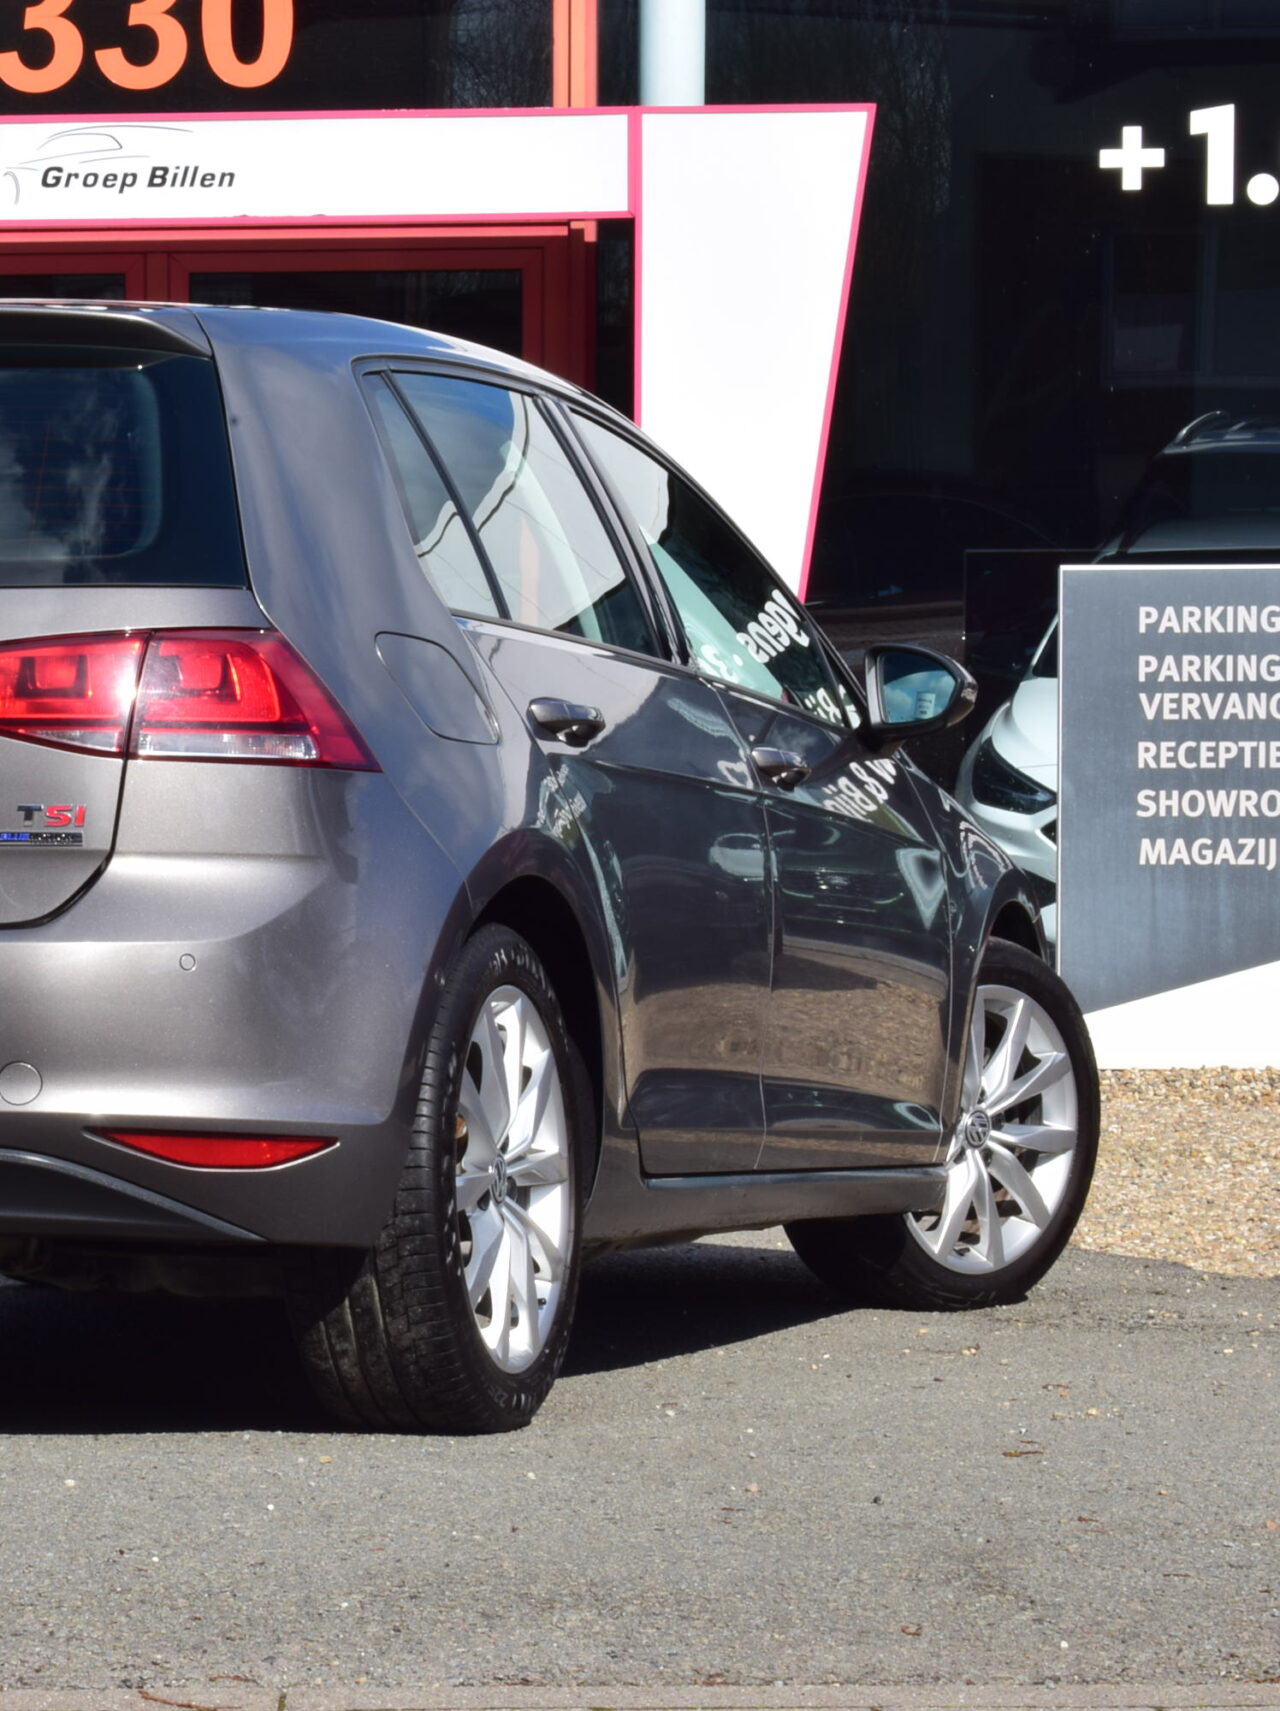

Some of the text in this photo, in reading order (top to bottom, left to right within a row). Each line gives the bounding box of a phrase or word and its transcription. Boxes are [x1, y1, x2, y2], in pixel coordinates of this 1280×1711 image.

[40, 165, 236, 194] Groep Billen
[1138, 605, 1280, 633] PARKING
[1138, 654, 1280, 682] PARKING
[1137, 741, 1280, 769] RECEPTIE
[17, 803, 87, 828] TSI
[1136, 789, 1280, 818] SHOWRO
[1138, 838, 1277, 870] MAGAZIJ
